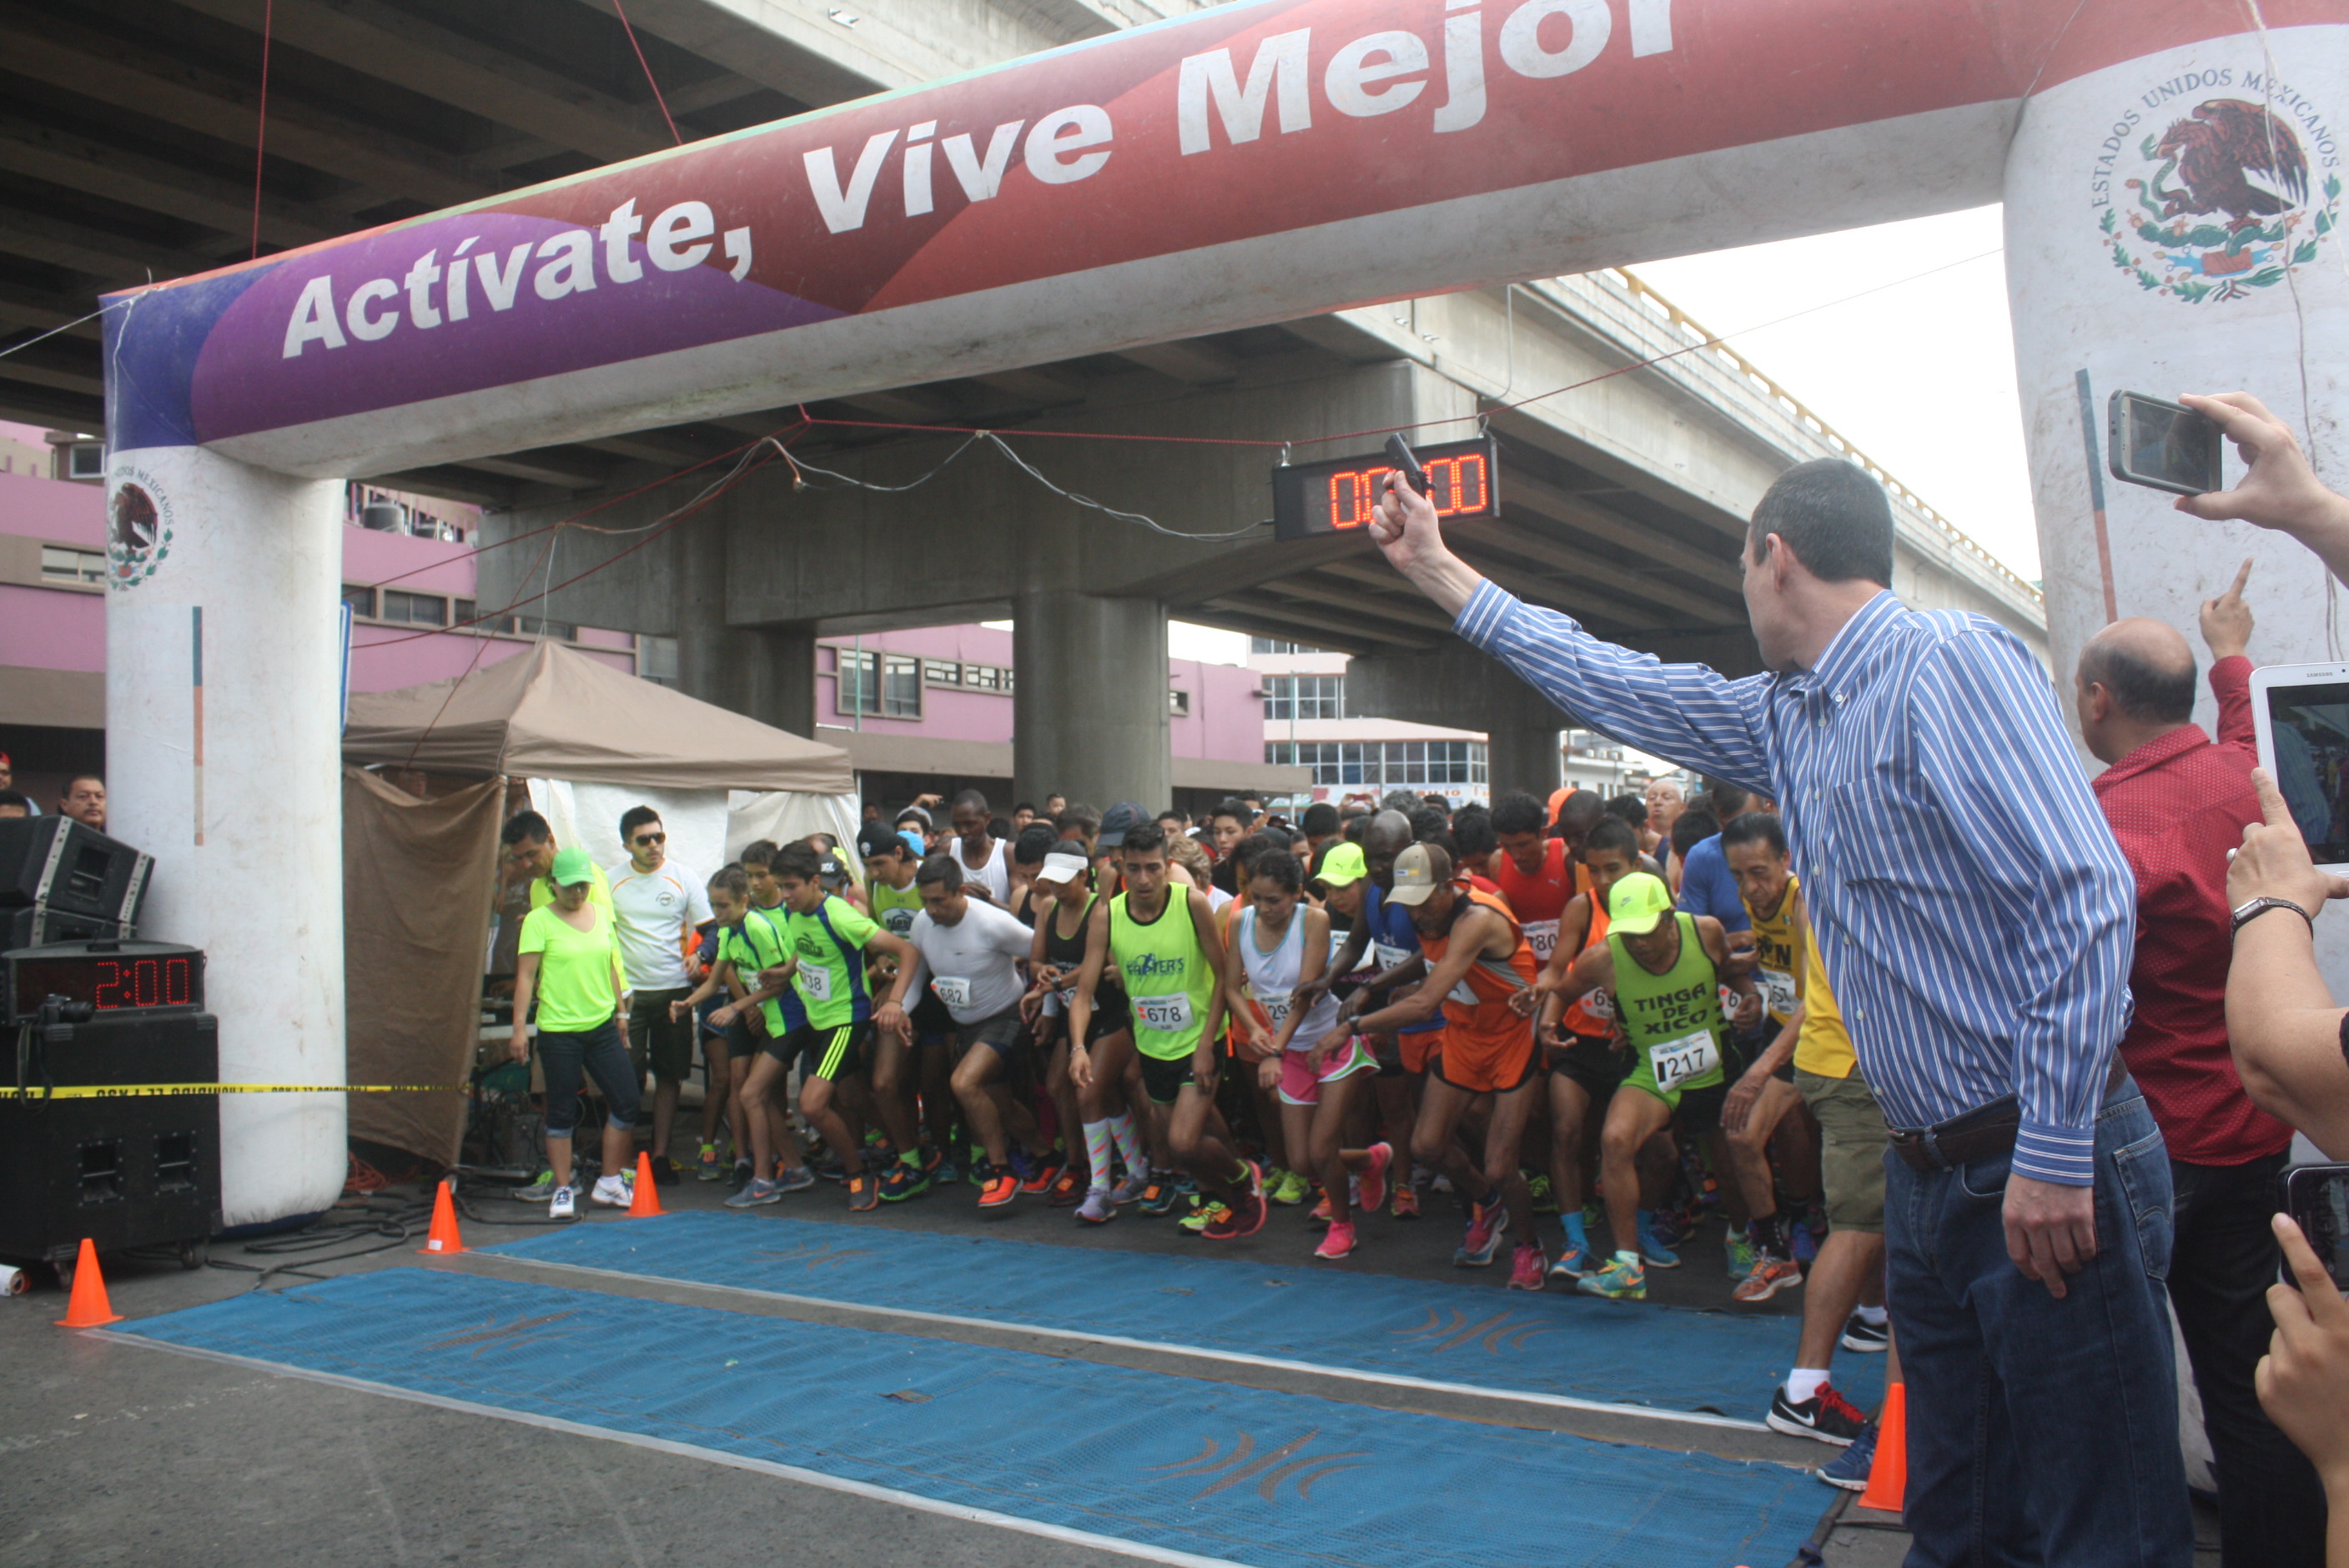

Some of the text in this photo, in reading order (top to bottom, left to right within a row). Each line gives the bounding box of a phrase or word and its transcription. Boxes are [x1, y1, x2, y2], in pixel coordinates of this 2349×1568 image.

[2091, 68, 2341, 209] ESTADOS UNIDOS MEXICANOS
[282, 197, 752, 359] Actívate,
[802, 103, 1114, 234] Vive
[137, 469, 174, 526] MEXICANOS
[95, 958, 189, 1009] 2:00
[940, 988, 963, 1004] 682
[1633, 982, 1707, 1013] TINGA
[1147, 1006, 1182, 1023] 678
[1644, 1008, 1708, 1035] XICO
[1662, 1003, 1690, 1019] DE
[1667, 1048, 1704, 1078] 217
